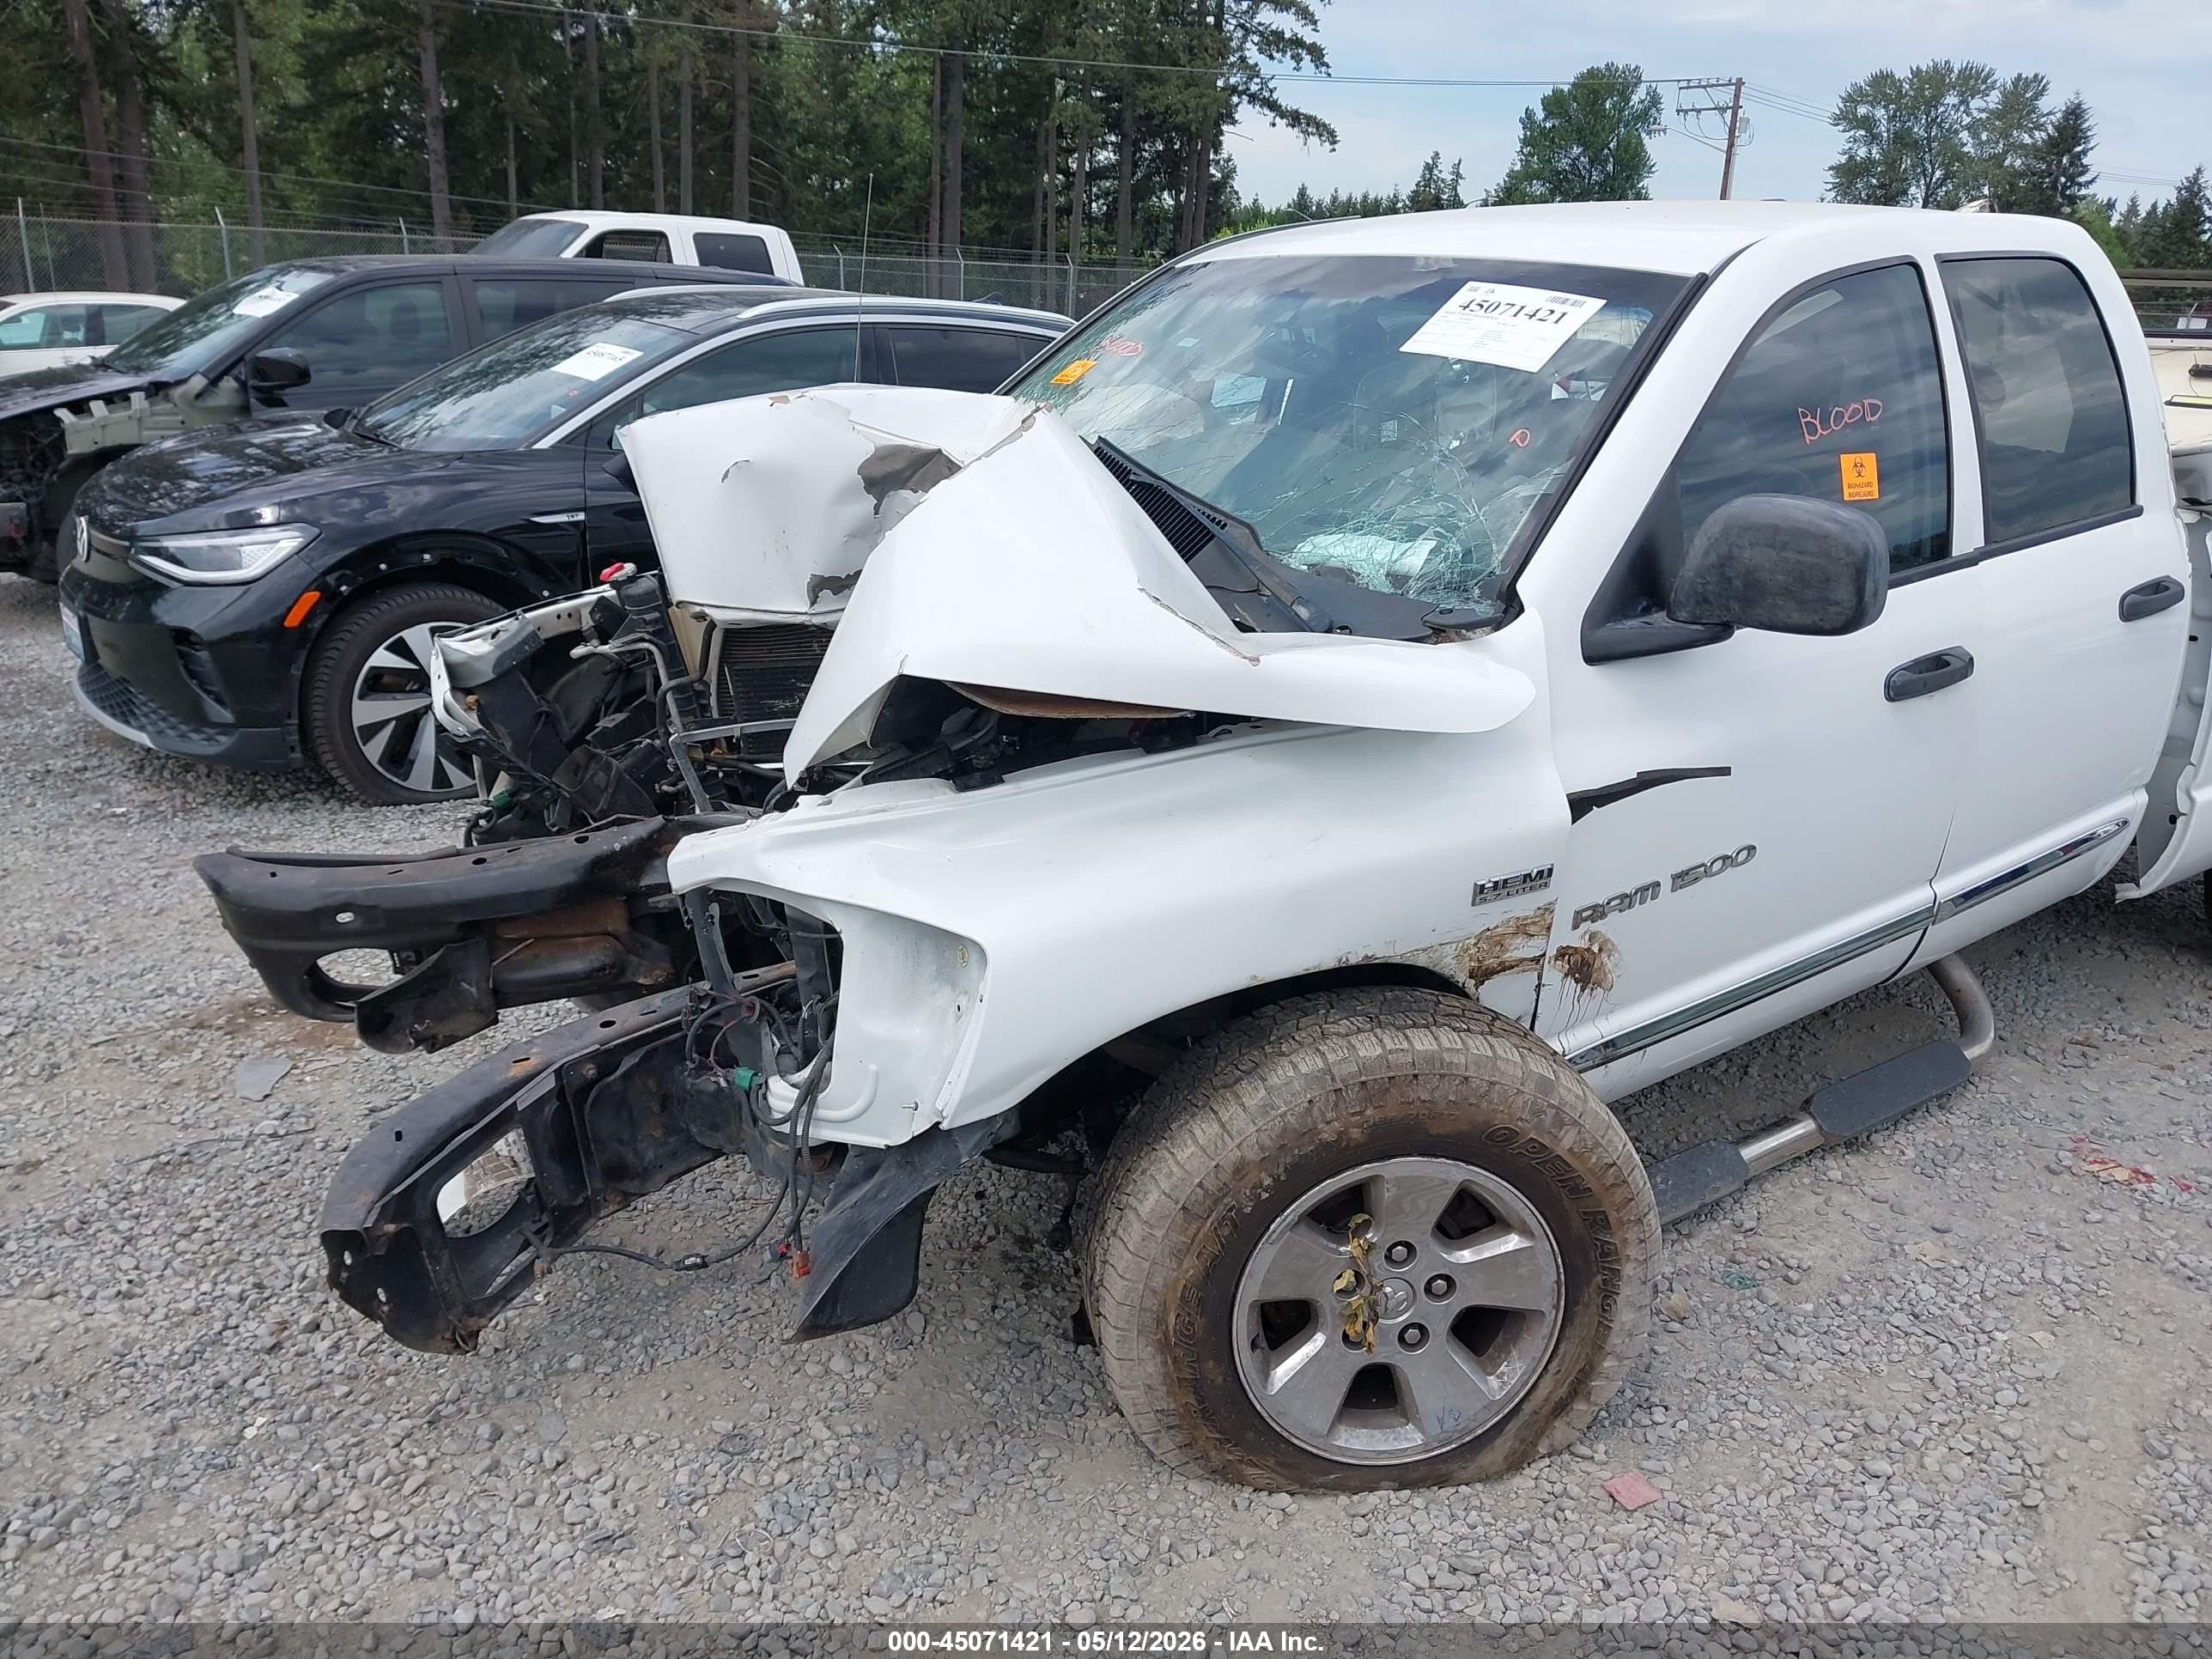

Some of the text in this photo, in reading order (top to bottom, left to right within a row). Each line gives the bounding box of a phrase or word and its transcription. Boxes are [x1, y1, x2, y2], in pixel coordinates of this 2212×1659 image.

[1457, 297, 1569, 325] 45071421
[1797, 398, 1883, 445] BLOOD
[1847, 481, 1874, 489] BIOHAZARD
[1475, 866, 1554, 895] HEMI
[1478, 881, 1548, 904] 5.7 LITER
[1571, 842, 1758, 931] RAM 1500
[1481, 1124, 1622, 1347] OPEN RANGE
